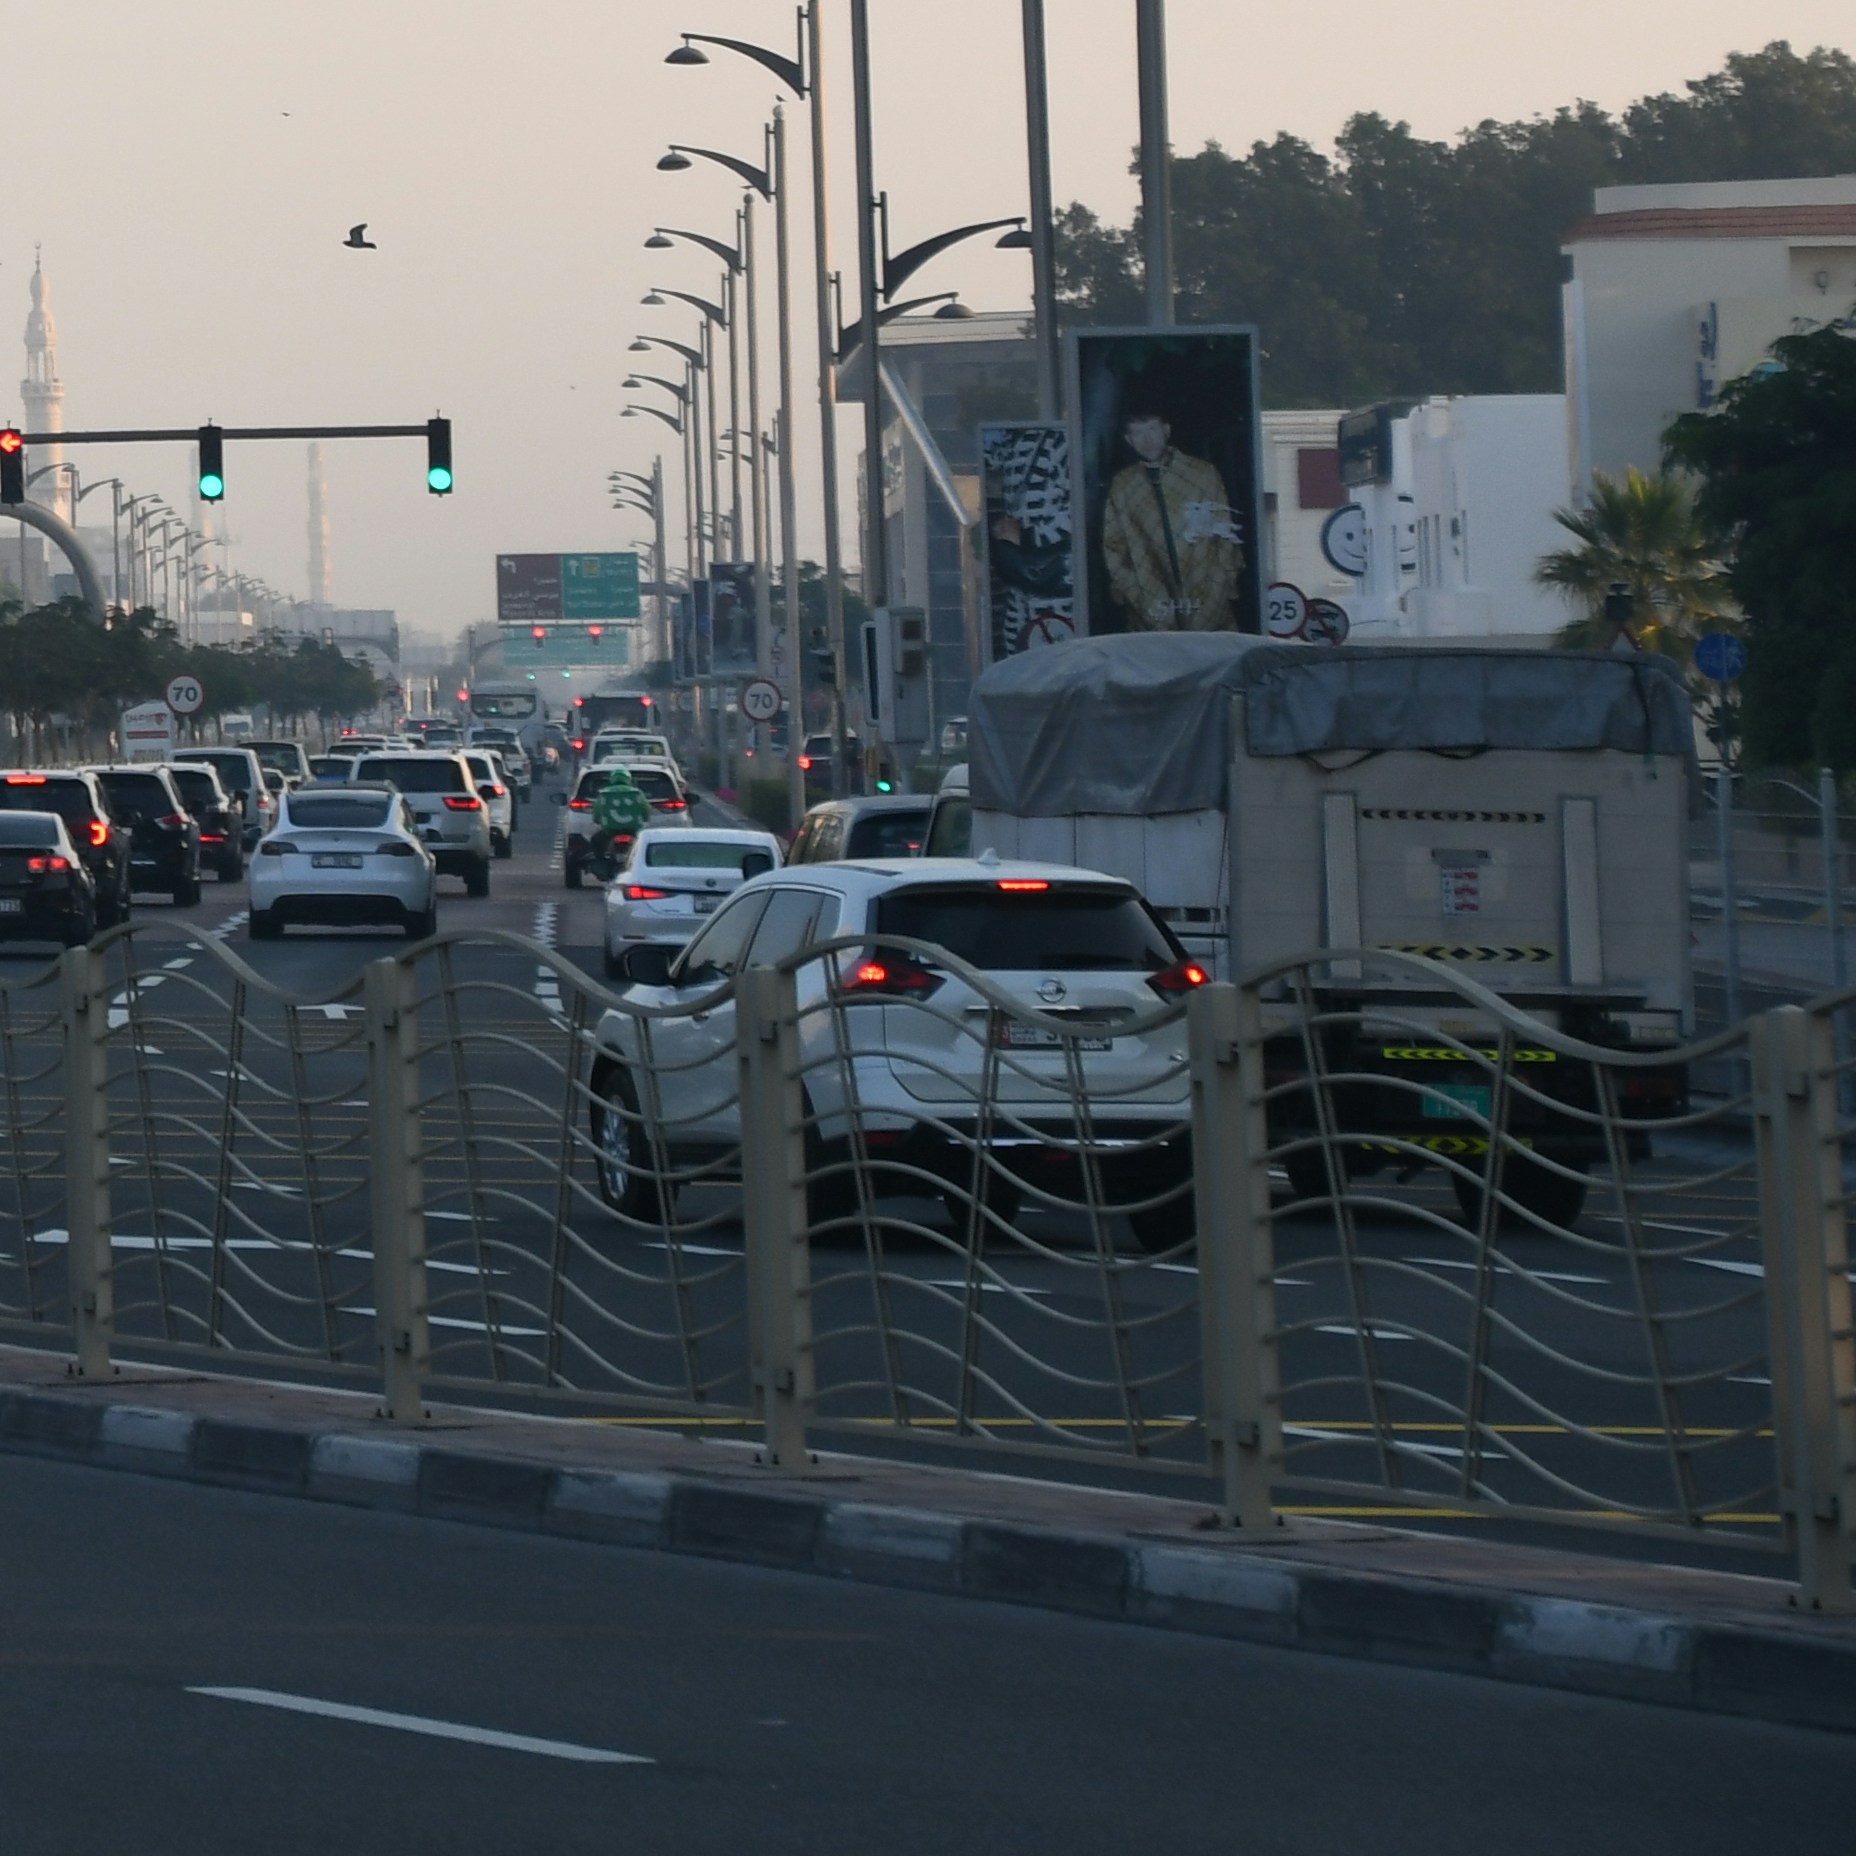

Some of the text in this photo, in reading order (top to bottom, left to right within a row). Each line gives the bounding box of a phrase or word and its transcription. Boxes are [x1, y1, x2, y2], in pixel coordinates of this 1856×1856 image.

[1270, 600, 1297, 621] 25
[173, 687, 198, 702] 70
[750, 693, 773, 710] 70
